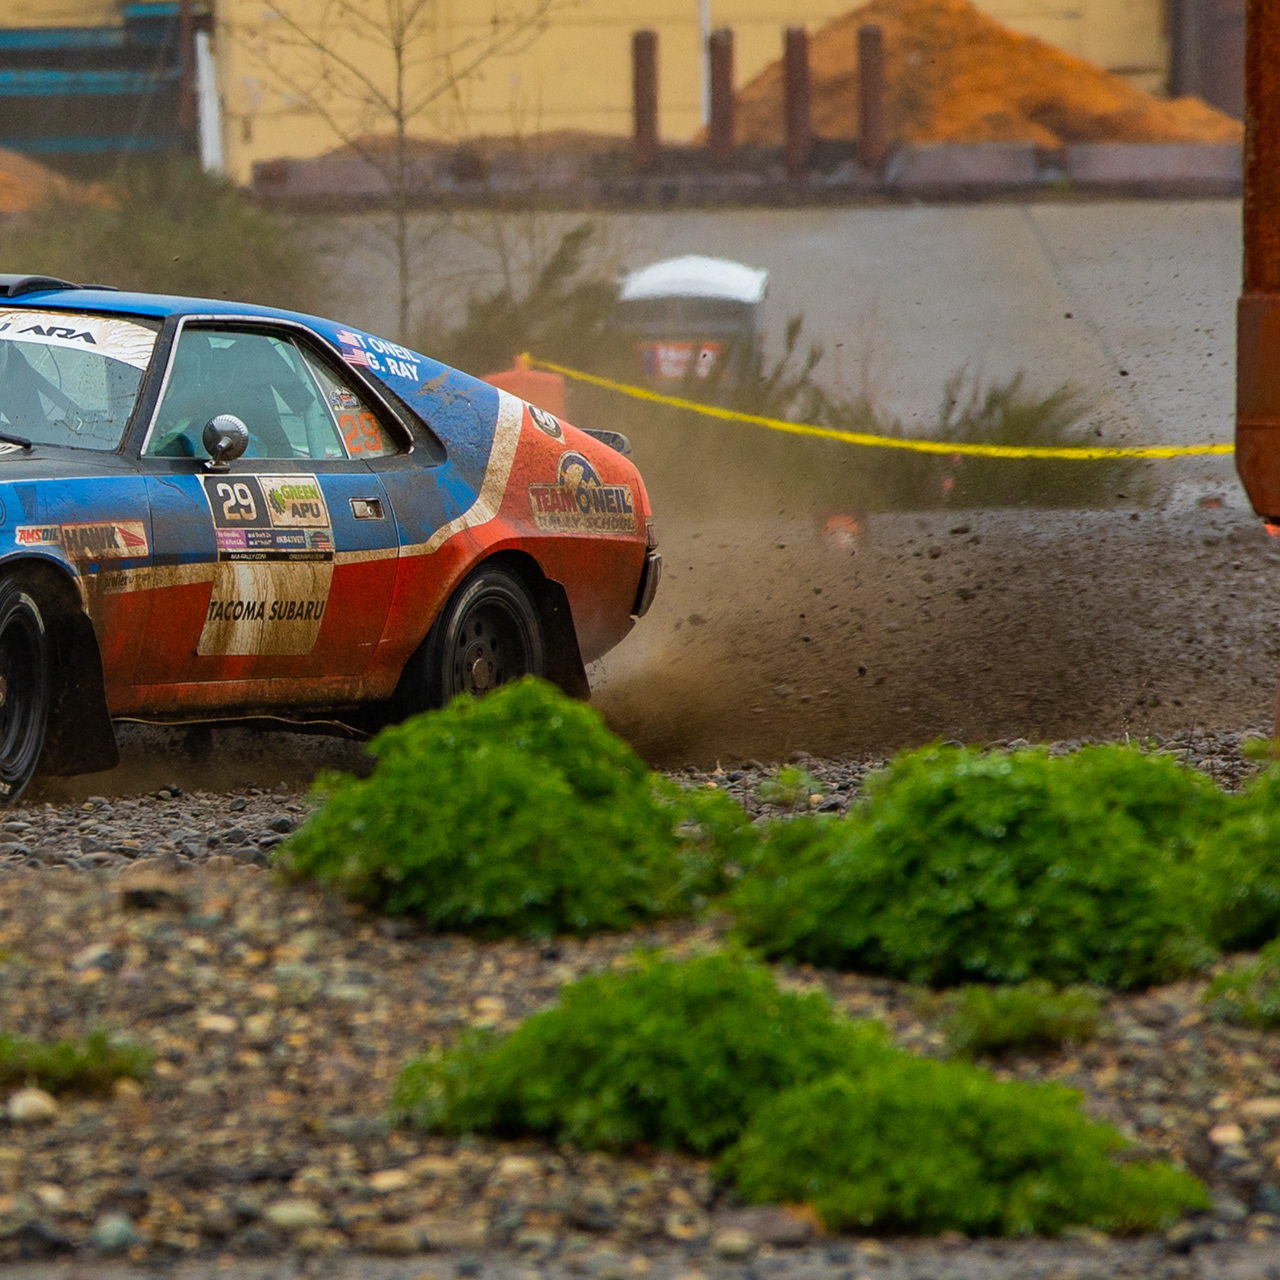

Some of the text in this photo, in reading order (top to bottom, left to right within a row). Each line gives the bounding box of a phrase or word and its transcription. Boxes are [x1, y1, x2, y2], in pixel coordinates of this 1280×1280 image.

[16, 324, 97, 345] ARA
[366, 352, 419, 381] G. RAY
[339, 412, 382, 453] 29
[216, 482, 257, 521] 29
[280, 484, 320, 500] GREEN
[531, 487, 578, 513] TEAM
[291, 502, 321, 519] APU
[18, 527, 60, 544] AMSOIL
[64, 525, 121, 551] HAWK
[208, 600, 326, 620] TACOMA SUBARU
